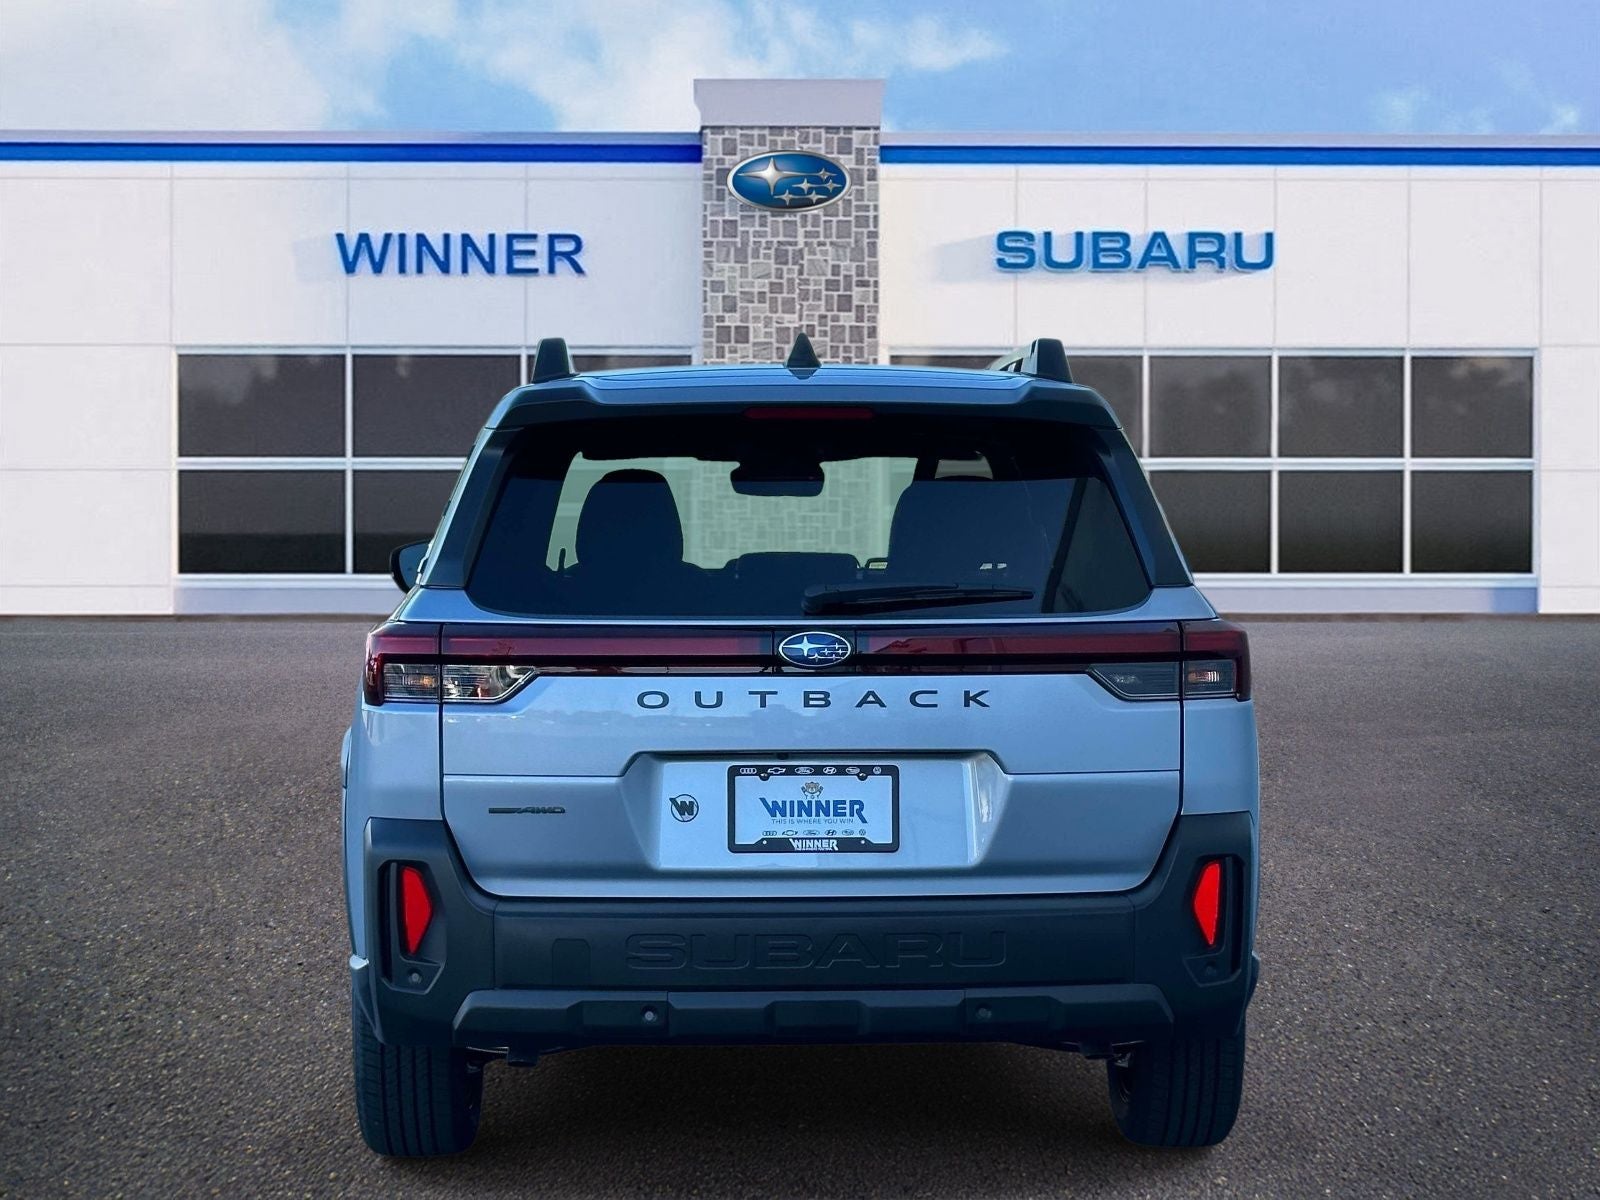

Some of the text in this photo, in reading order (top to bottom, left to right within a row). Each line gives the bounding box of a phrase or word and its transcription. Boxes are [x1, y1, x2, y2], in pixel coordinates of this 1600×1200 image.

[335, 232, 586, 275] WINNER
[996, 230, 1274, 271] SUBARU
[636, 689, 990, 709] OUTBACK
[759, 797, 868, 824] WINNER
[788, 838, 839, 851] WINNER
[624, 931, 1007, 970] SUBARU
